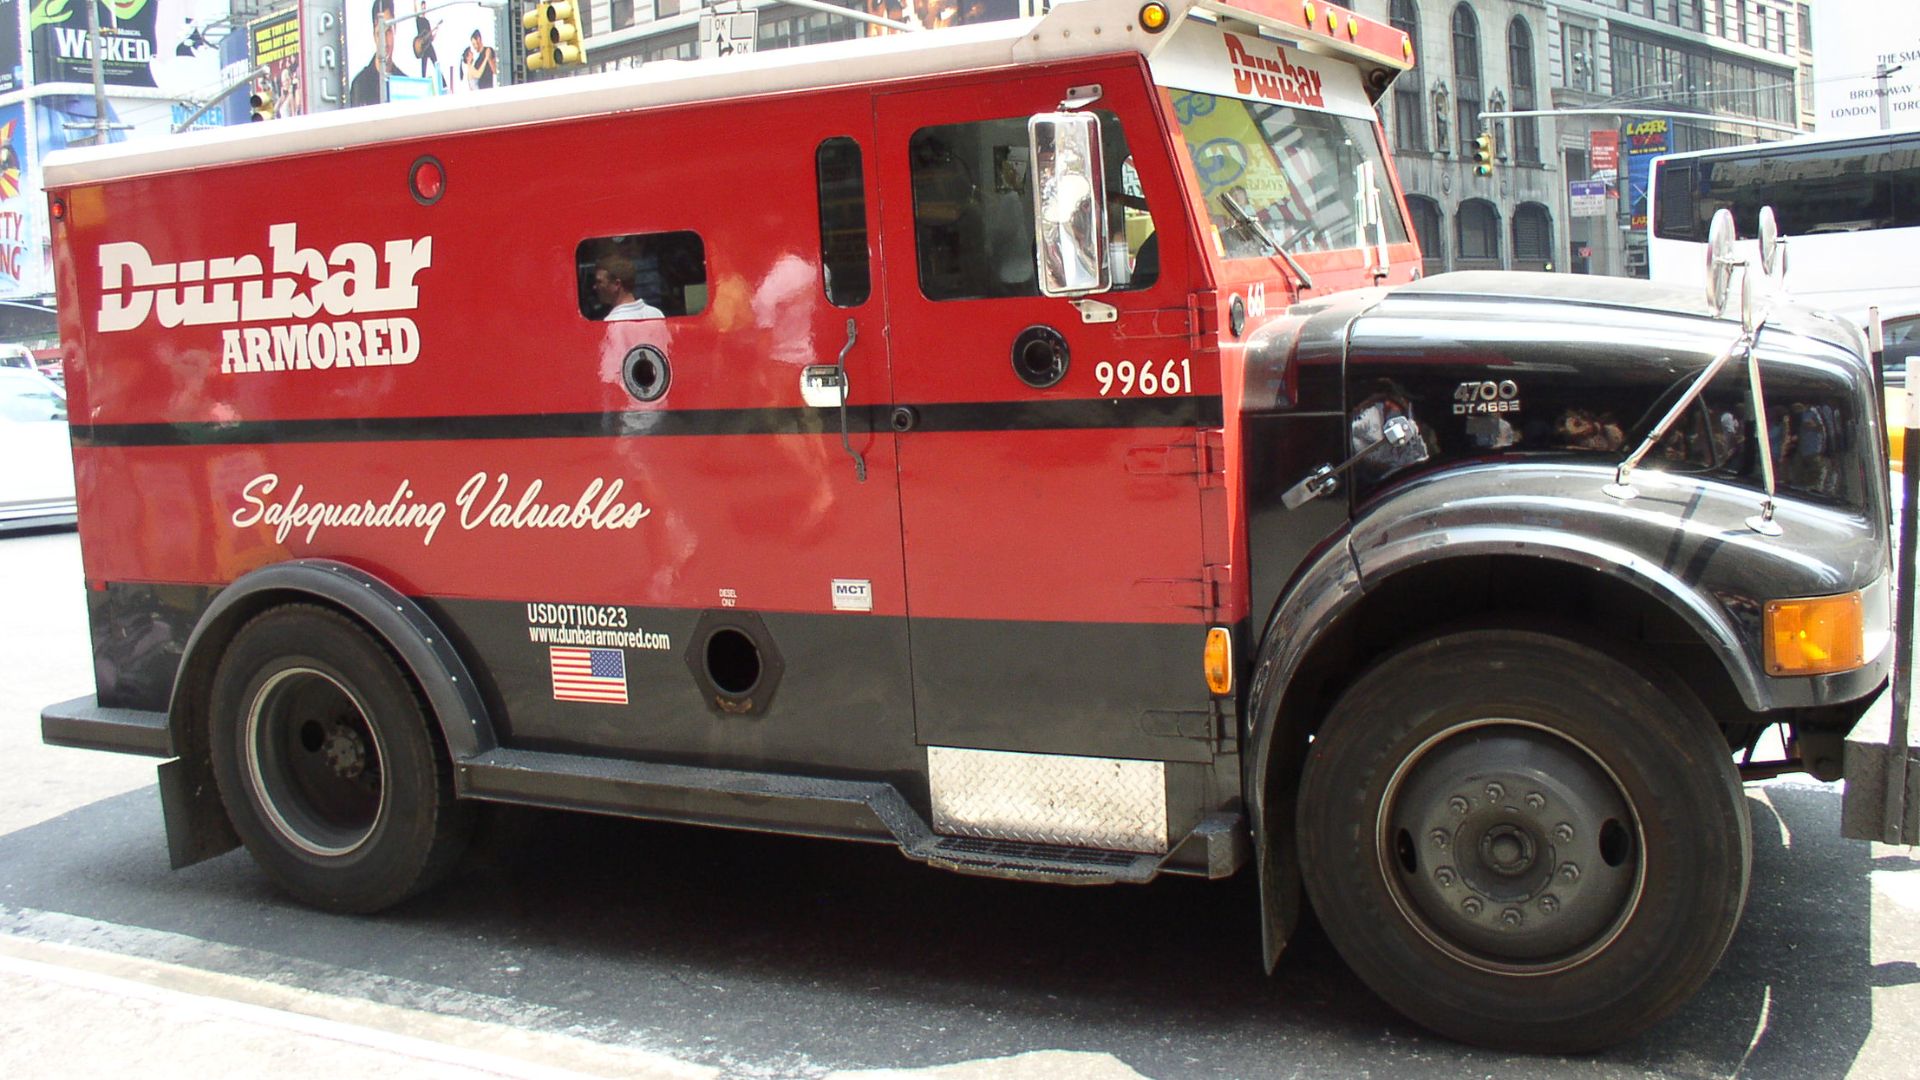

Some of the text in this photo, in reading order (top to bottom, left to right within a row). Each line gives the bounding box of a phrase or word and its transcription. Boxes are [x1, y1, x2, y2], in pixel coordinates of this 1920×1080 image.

[715, 17, 727, 31] OK
[737, 42, 749, 54] OK
[1877, 53, 1896, 64] THE
[1223, 32, 1325, 108] Dunbar
[1850, 84, 1913, 100] BROWAY
[1831, 105, 1877, 119] LONDON
[1626, 119, 1668, 136] LAZER
[97, 222, 432, 333] Dunbar
[1247, 281, 1265, 318] 661
[221, 317, 420, 374] ARMORED
[1095, 358, 1192, 396] 99661
[1454, 379, 1518, 401] 4700
[1453, 403, 1475, 415] DT
[232, 471, 651, 546] Safeguarding Valuables
[836, 585, 866, 595] MCT
[721, 598, 735, 607] ONLY
[527, 602, 628, 628] USDOT110623
[529, 623, 671, 650] www.dunbararmored.com
